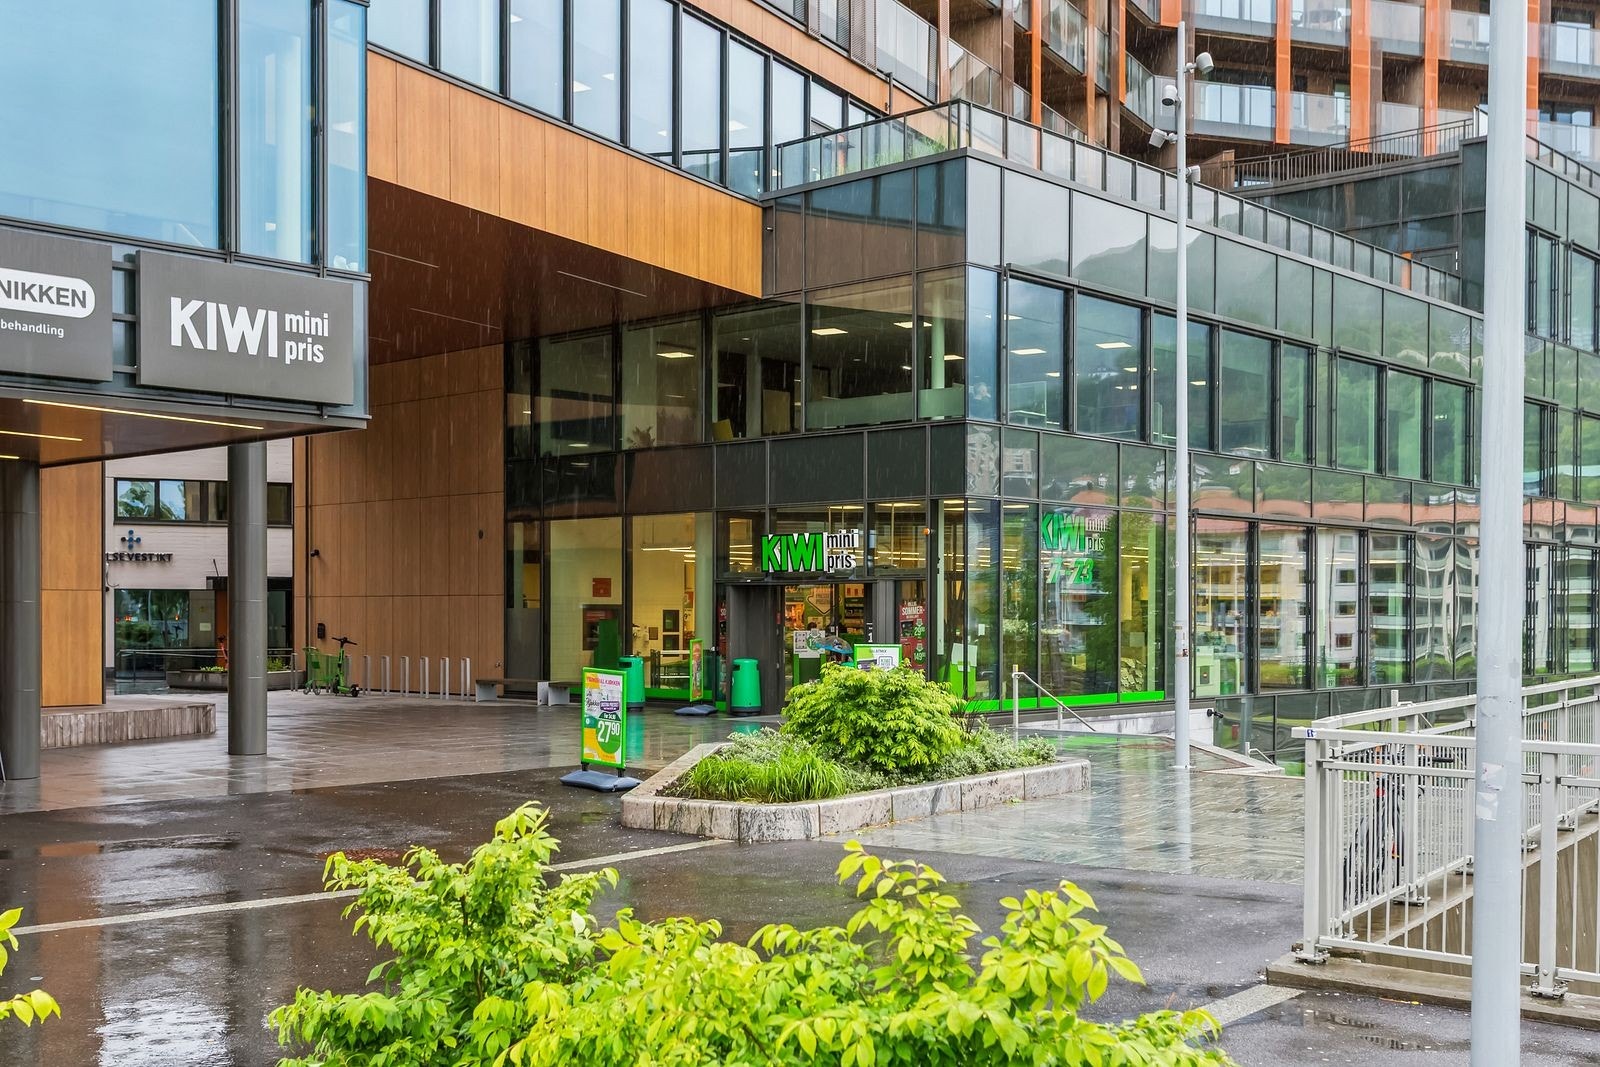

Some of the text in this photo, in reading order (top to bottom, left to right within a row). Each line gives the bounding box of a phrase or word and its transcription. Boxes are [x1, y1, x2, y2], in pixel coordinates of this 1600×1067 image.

[0, 319, 65, 338] behandling
[170, 296, 278, 358] KIWI
[285, 310, 329, 337] mini
[285, 337, 325, 365] pris
[826, 529, 858, 548] mini
[1041, 511, 1086, 551] KIWI
[127, 553, 155, 562] VEST
[156, 553, 174, 562] IKT
[761, 532, 824, 572] KIWI
[826, 551, 855, 573] pris
